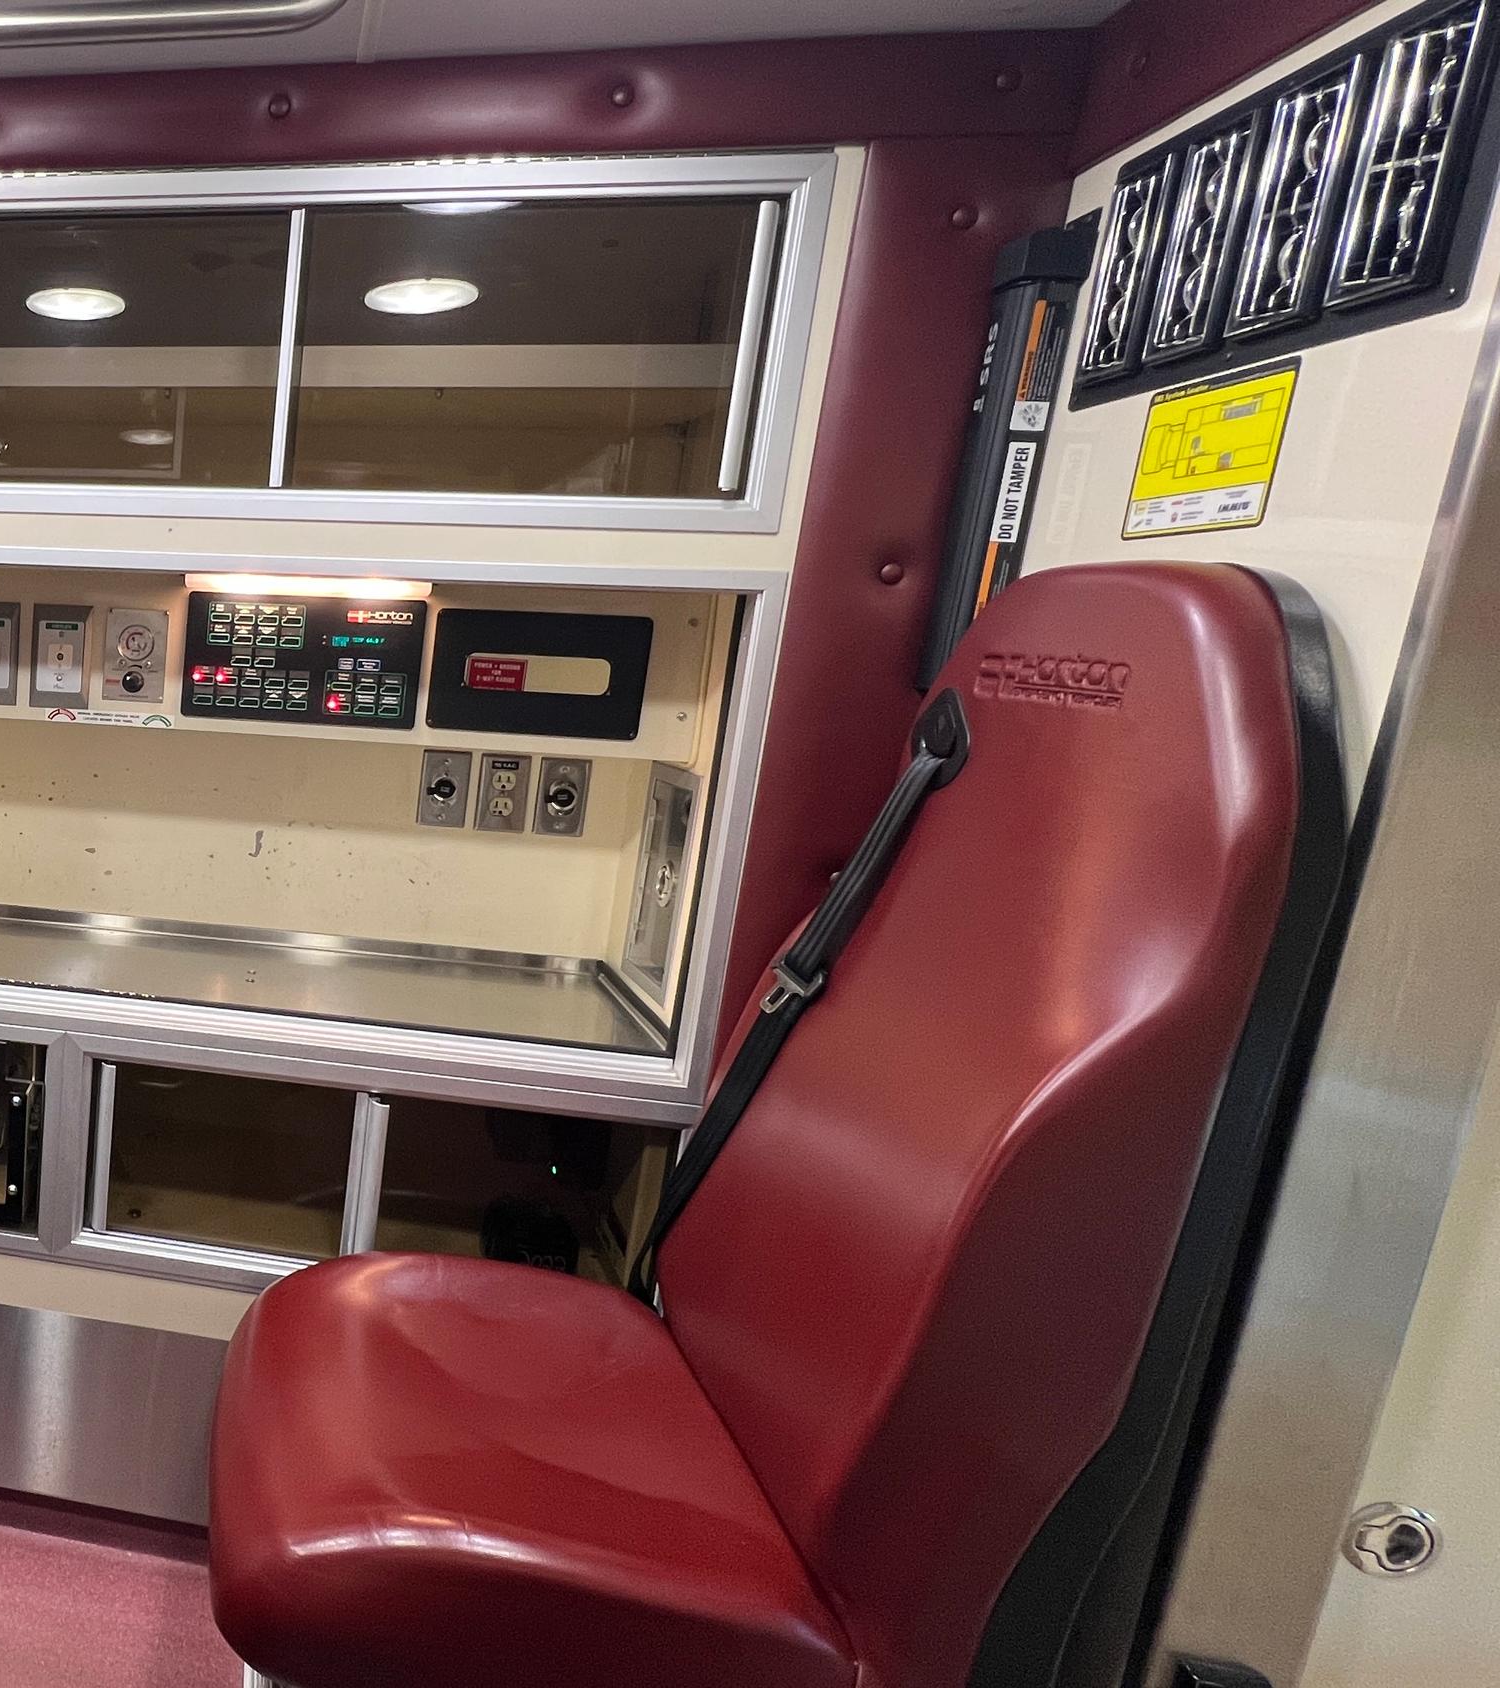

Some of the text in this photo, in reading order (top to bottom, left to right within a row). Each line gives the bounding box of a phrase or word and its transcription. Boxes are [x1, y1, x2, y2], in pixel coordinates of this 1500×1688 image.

[979, 322, 999, 386] SRS
[998, 446, 1031, 540] DO NOT TAMPER
[368, 610, 413, 621] Horton
